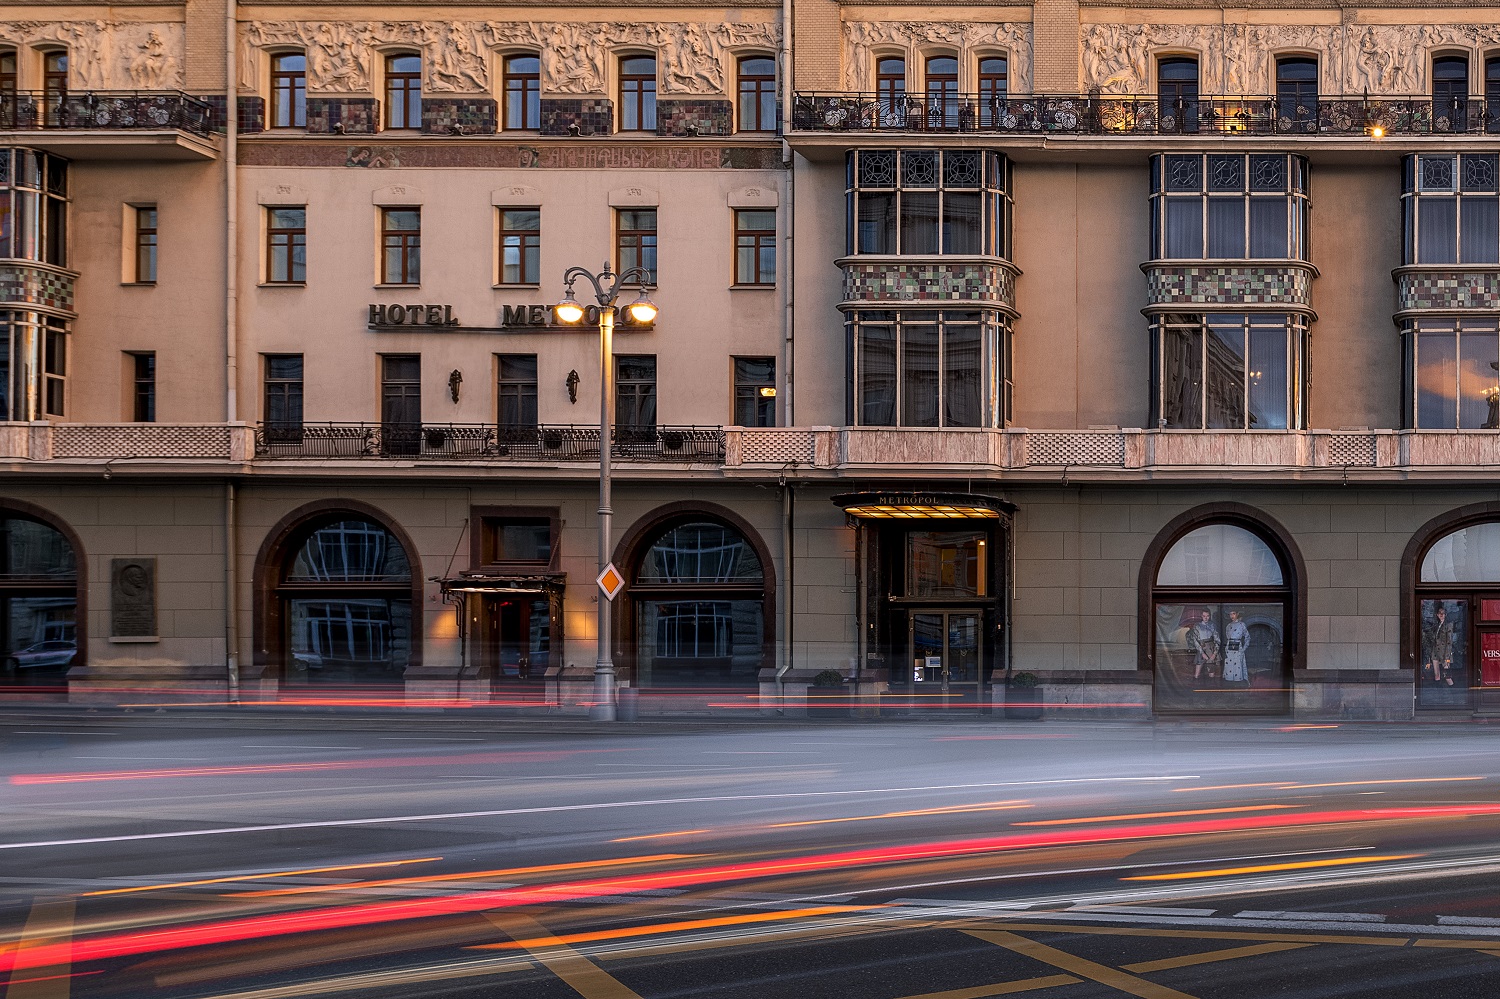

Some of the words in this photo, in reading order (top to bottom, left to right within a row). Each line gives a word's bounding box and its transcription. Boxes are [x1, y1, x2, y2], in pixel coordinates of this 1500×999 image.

[368, 304, 460, 326] HOTEL
[501, 304, 656, 326] METOO
[879, 496, 939, 505] METROPOL
